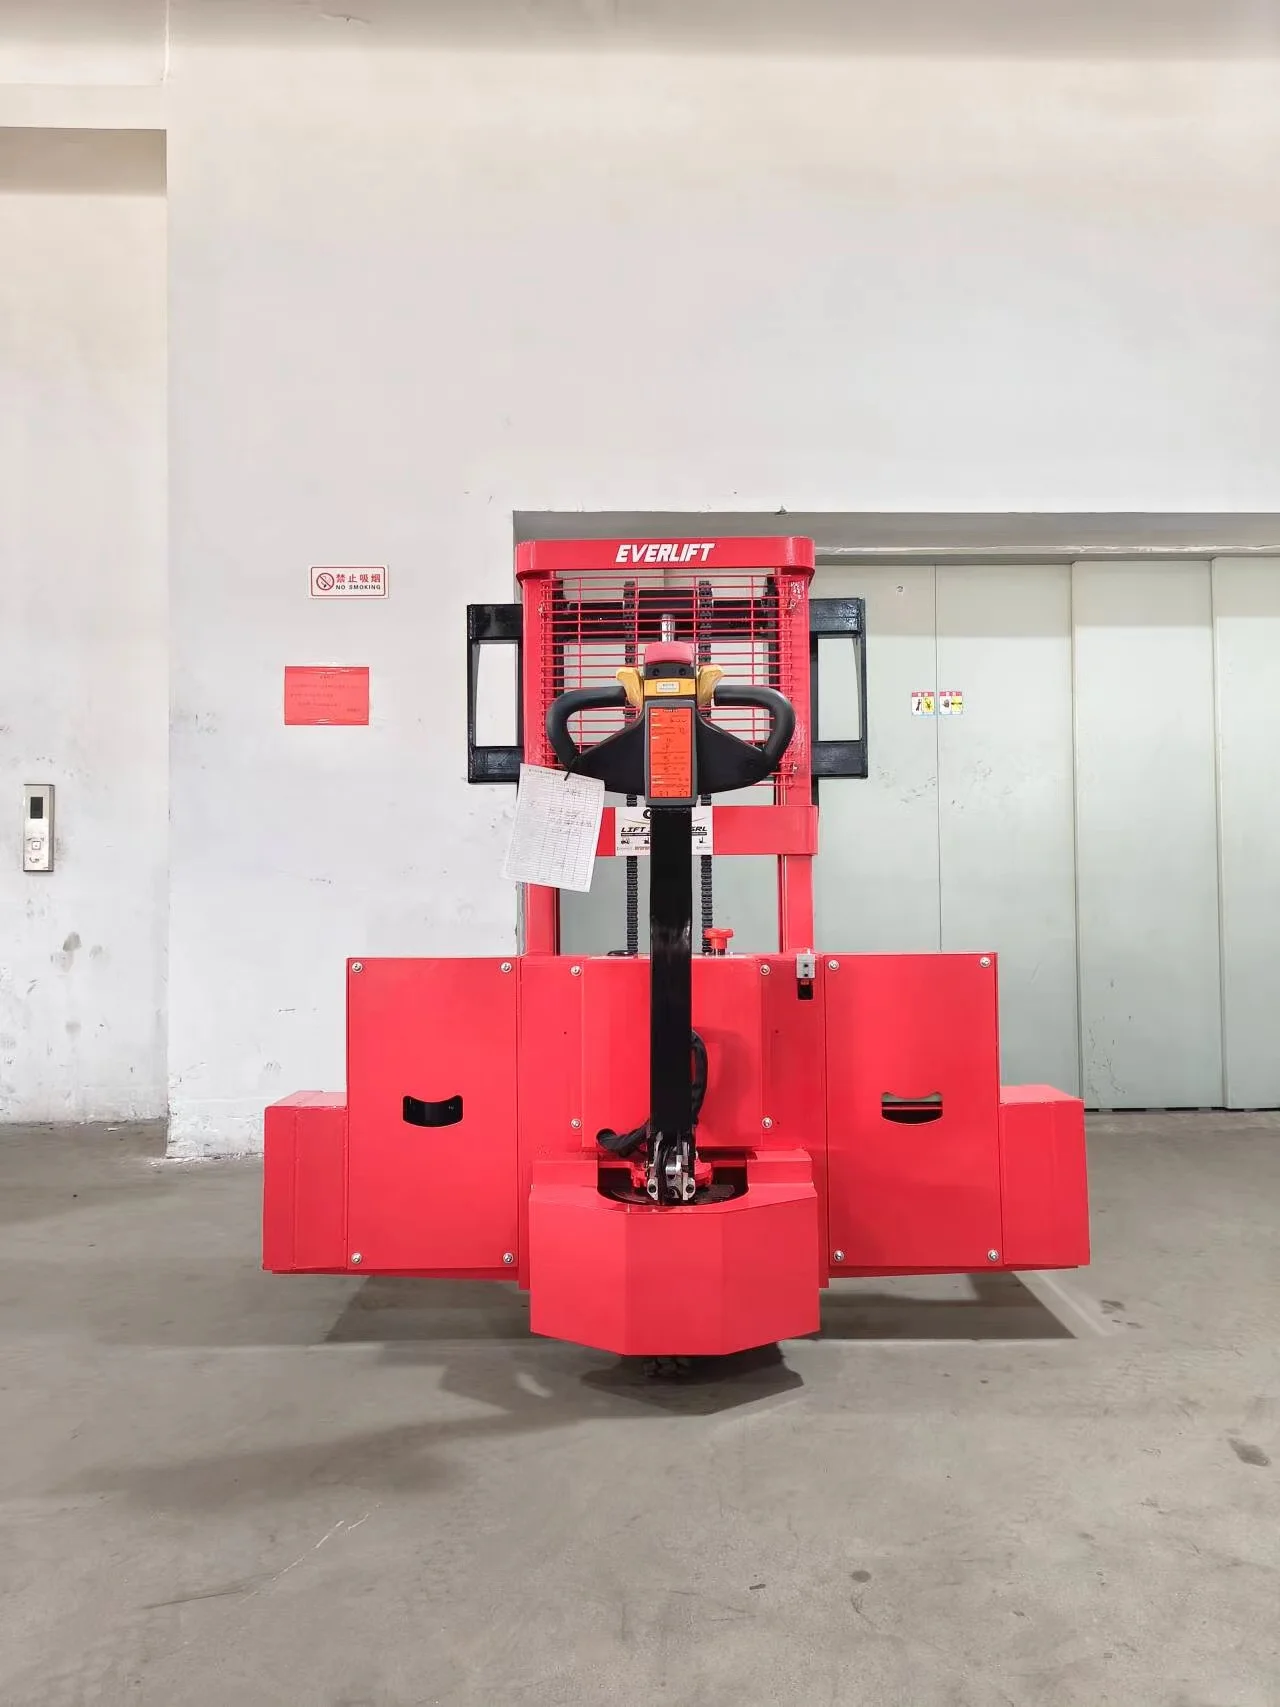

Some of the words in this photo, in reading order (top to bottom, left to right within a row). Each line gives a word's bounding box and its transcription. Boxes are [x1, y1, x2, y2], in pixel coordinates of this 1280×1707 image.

[615, 543, 715, 563] EVERLIFT
[336, 574, 380, 583] 禁止吸烟
